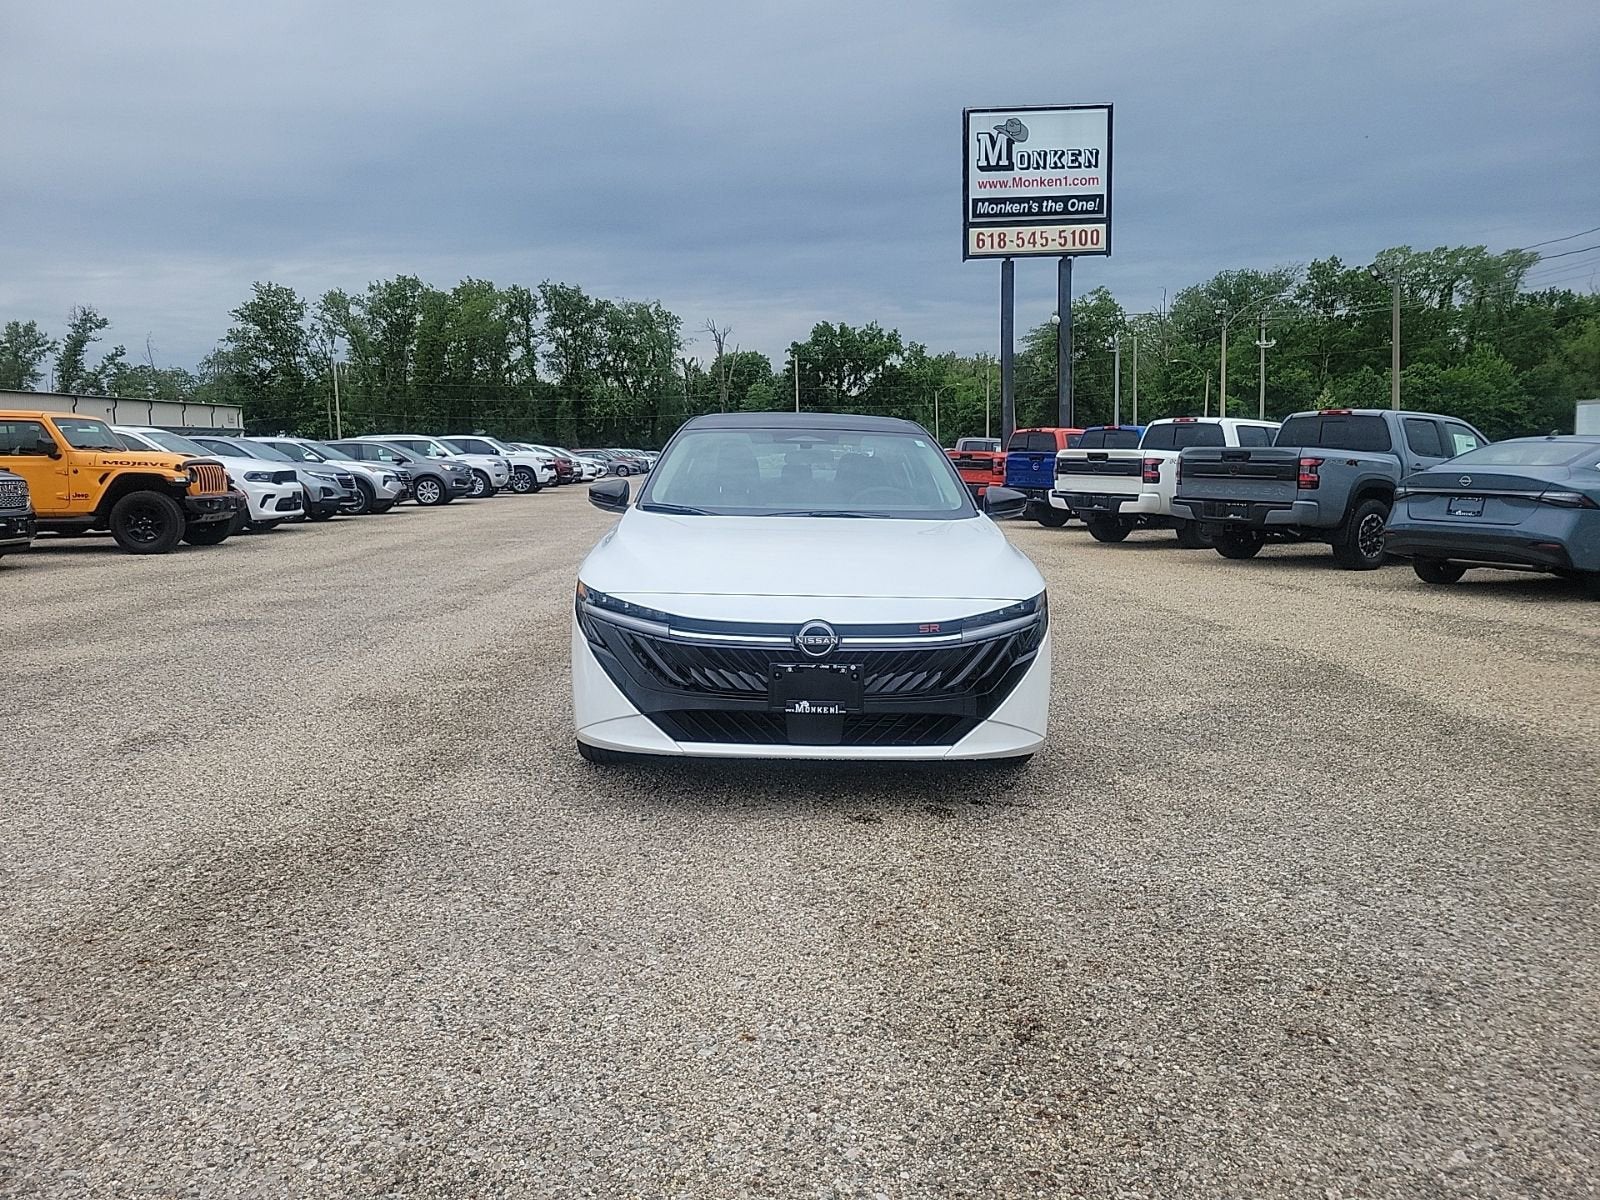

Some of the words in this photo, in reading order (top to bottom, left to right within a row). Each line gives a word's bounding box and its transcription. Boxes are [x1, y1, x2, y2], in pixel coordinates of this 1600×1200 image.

[977, 131, 1099, 172] MONKEN
[977, 176, 1099, 189] www.Monken1.com
[976, 201, 1039, 214] Monken's
[1042, 200, 1063, 212] the
[1067, 198, 1099, 211] One!
[976, 229, 1100, 249] 618-545-5100
[919, 623, 940, 633] SR
[795, 635, 838, 644] NISSAN
